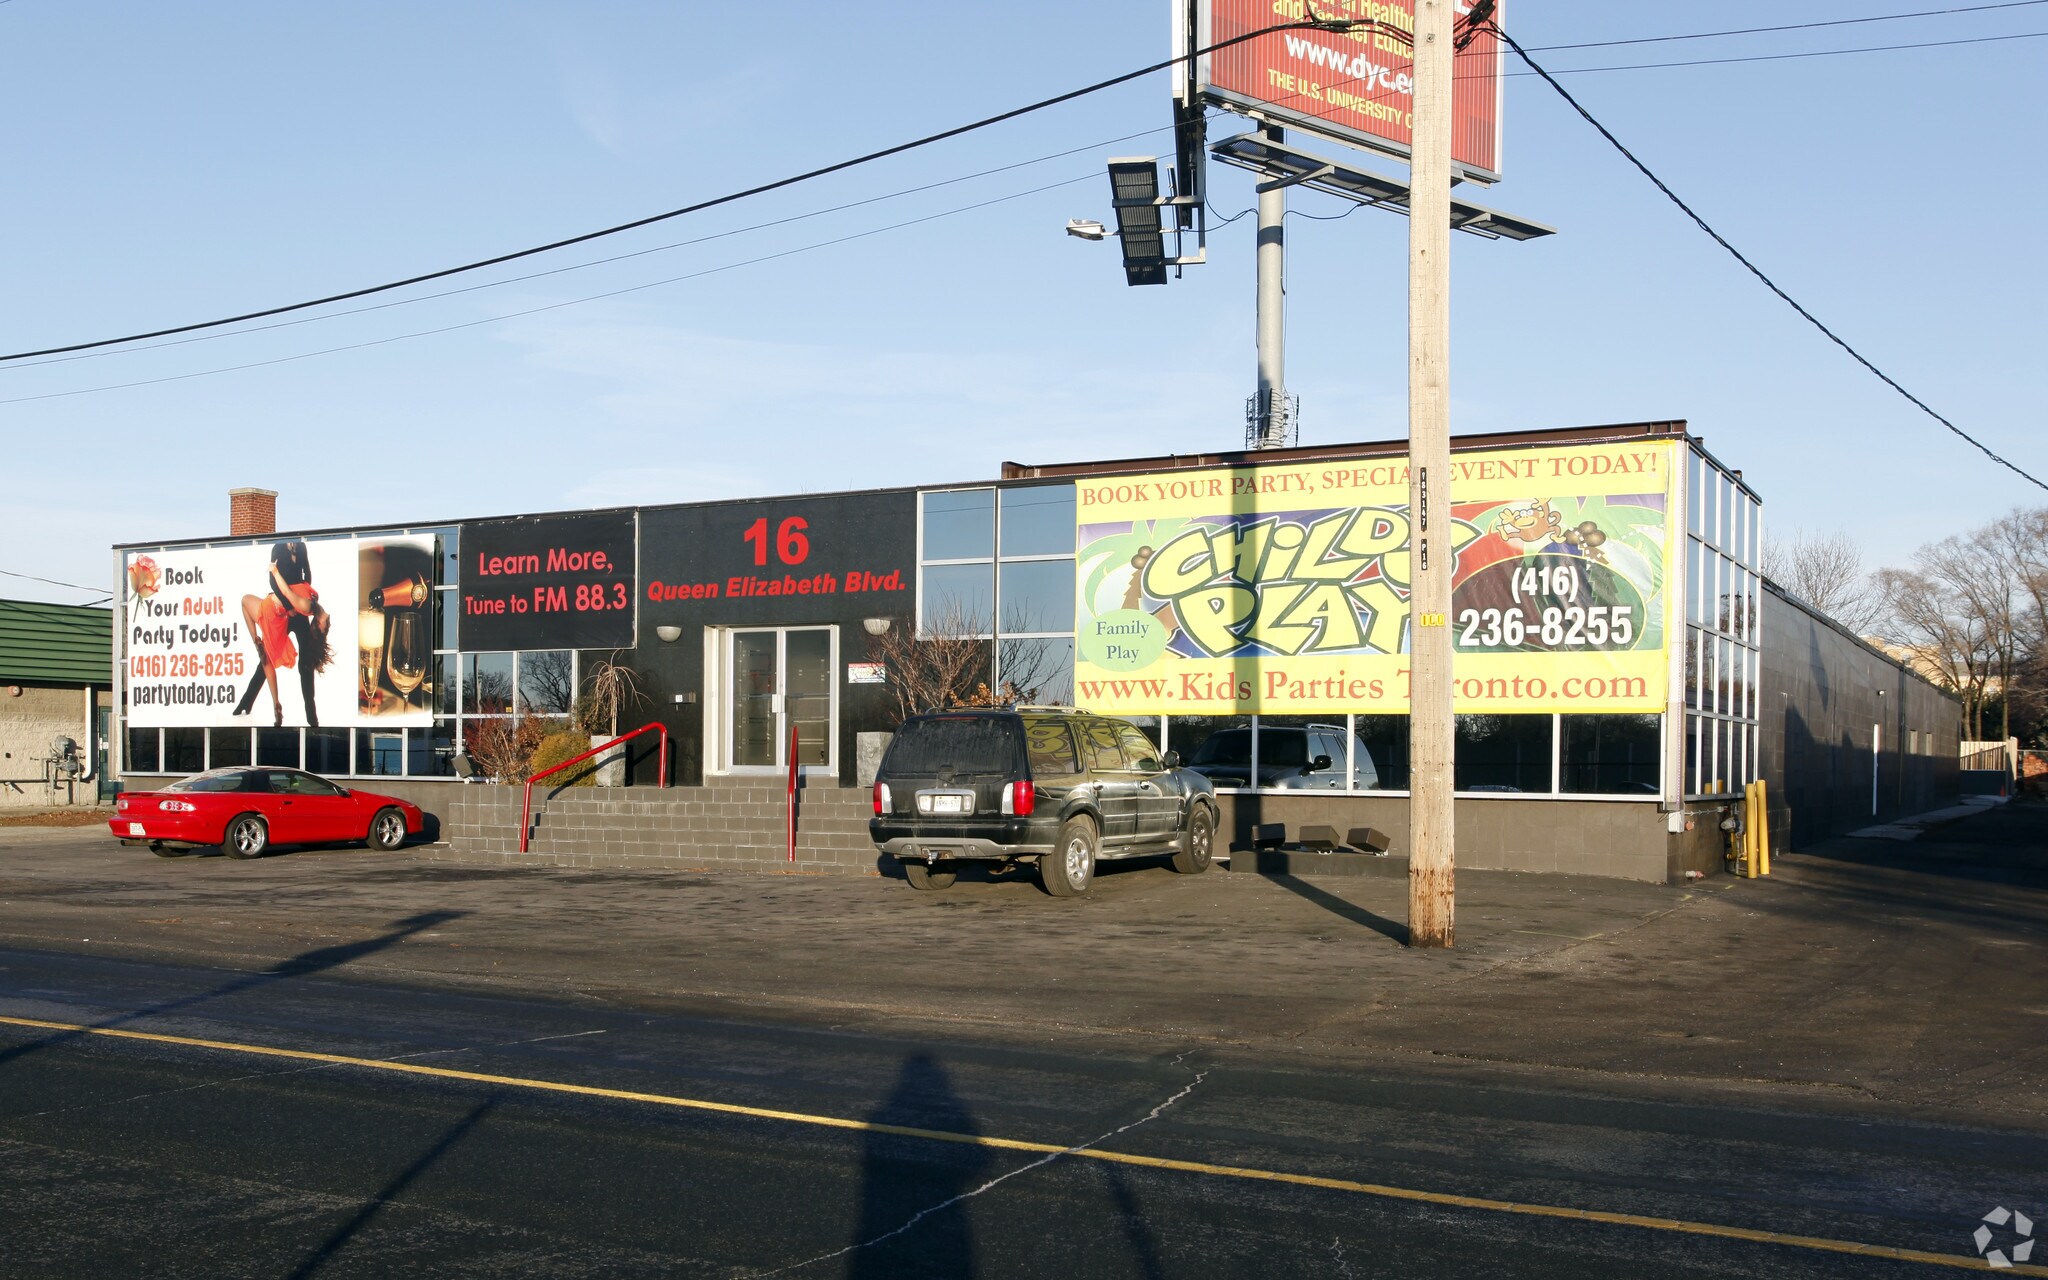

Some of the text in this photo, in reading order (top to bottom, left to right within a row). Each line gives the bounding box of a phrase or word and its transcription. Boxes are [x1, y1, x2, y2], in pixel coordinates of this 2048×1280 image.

[1267, 68, 1295, 92] THE
[1298, 78, 1324, 101] U.S.
[1327, 88, 1402, 126] UNIVERSITY
[1082, 484, 1149, 506] BOOK
[1154, 478, 1224, 501] YOUR
[1230, 472, 1314, 496] PARTY,
[1322, 463, 1411, 490] SPECIA
[1546, 452, 1659, 477] TODAY!
[742, 515, 810, 567] 16
[166, 566, 204, 585] Book
[478, 547, 615, 577] Learn More,
[465, 582, 628, 616] Tune to FM 88.3
[646, 568, 907, 602] Queen Elizabeth Blvd.
[1510, 566, 1580, 603] (416)
[145, 596, 223, 618] Your Adult
[132, 623, 238, 650] Party Today!
[1095, 620, 1150, 638] Family
[1459, 606, 1633, 647] 236-8255
[130, 652, 244, 678] (416) 236-8255
[1105, 644, 1140, 661] Play
[132, 681, 236, 707] partytoday.ca
[1263, 670, 1384, 701] Parties
